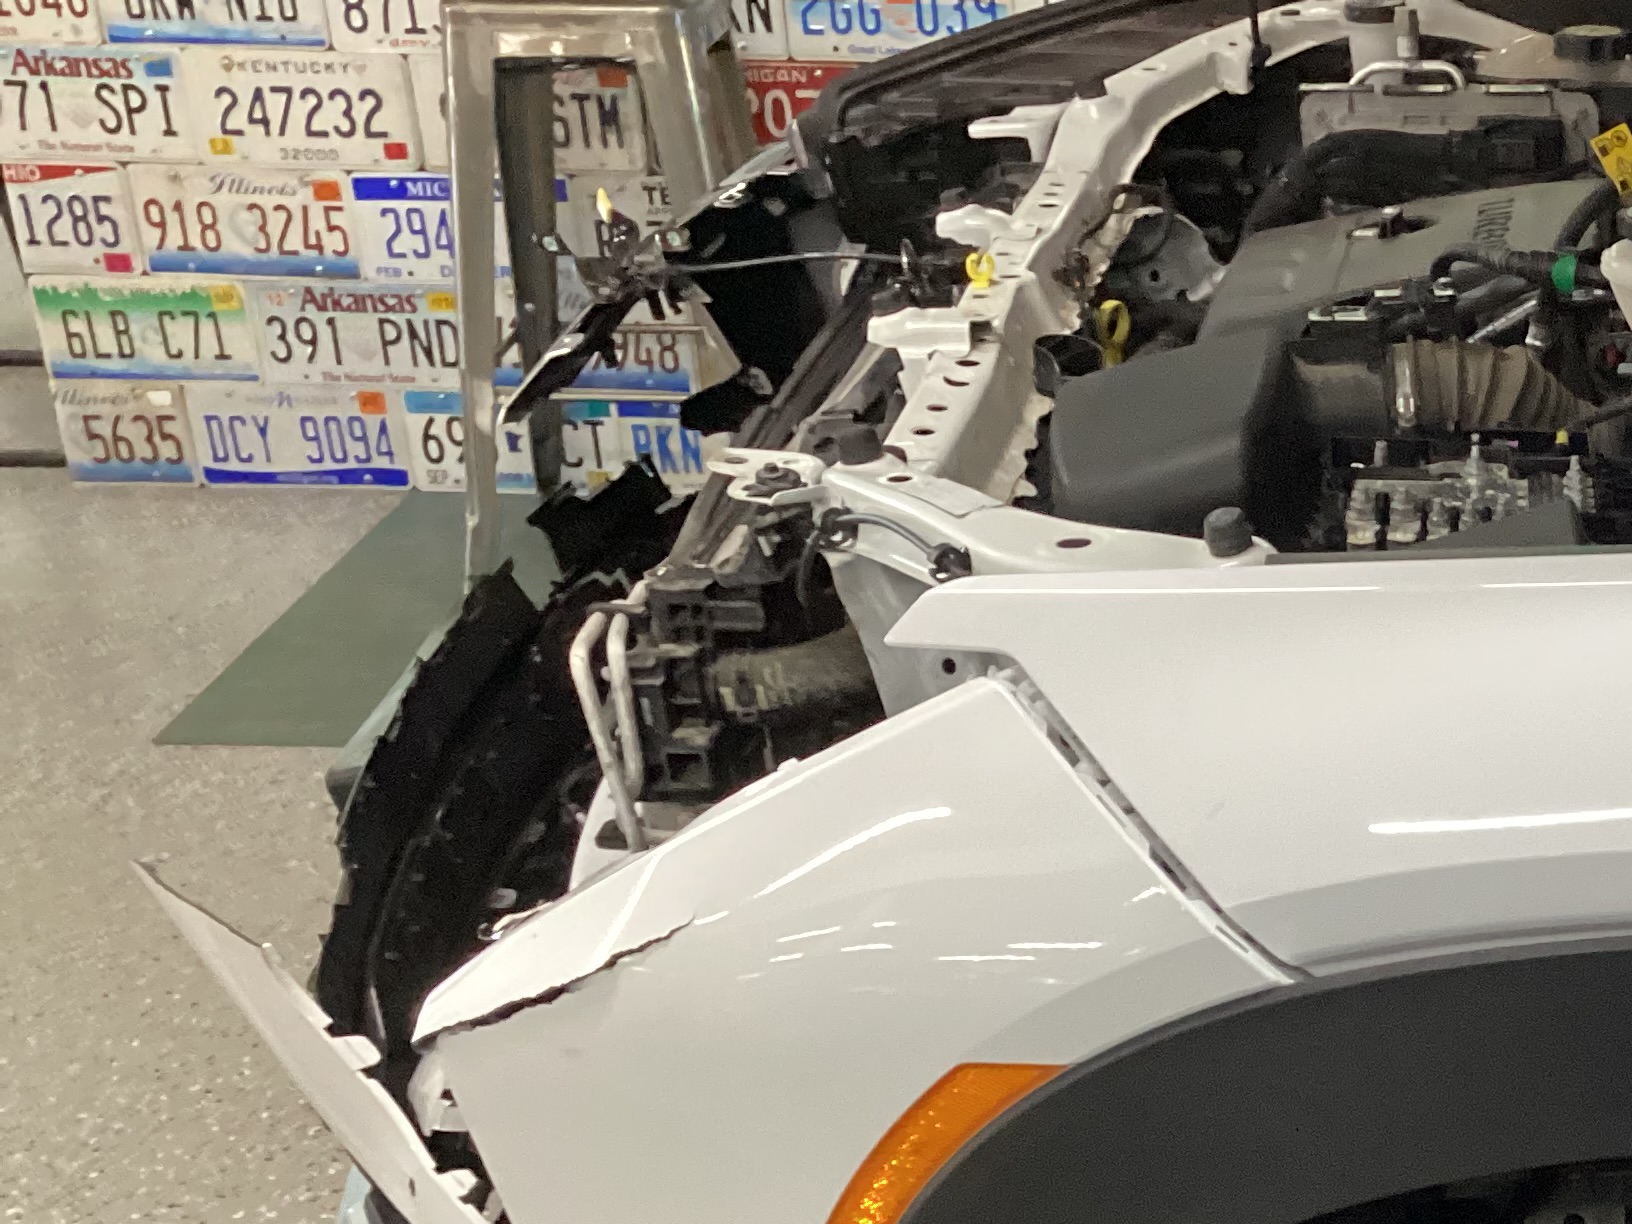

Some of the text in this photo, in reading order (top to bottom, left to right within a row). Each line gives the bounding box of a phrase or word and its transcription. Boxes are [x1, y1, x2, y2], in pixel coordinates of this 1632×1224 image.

[11, 48, 134, 79] Arkansas
[235, 58, 351, 75] KENTUCKY
[94, 82, 178, 137] SPI
[214, 85, 389, 139] 247232
[208, 172, 299, 197] Illinois
[18, 193, 121, 249] 1285
[143, 198, 350, 257] 918 3245
[380, 207, 455, 259] 294
[300, 286, 418, 313] Arkansas
[61, 308, 233, 361] 6LB C71
[265, 315, 343, 366] 391
[377, 317, 461, 368] PND
[82, 414, 184, 464] 5635
[203, 415, 396, 465] DCY 9094
